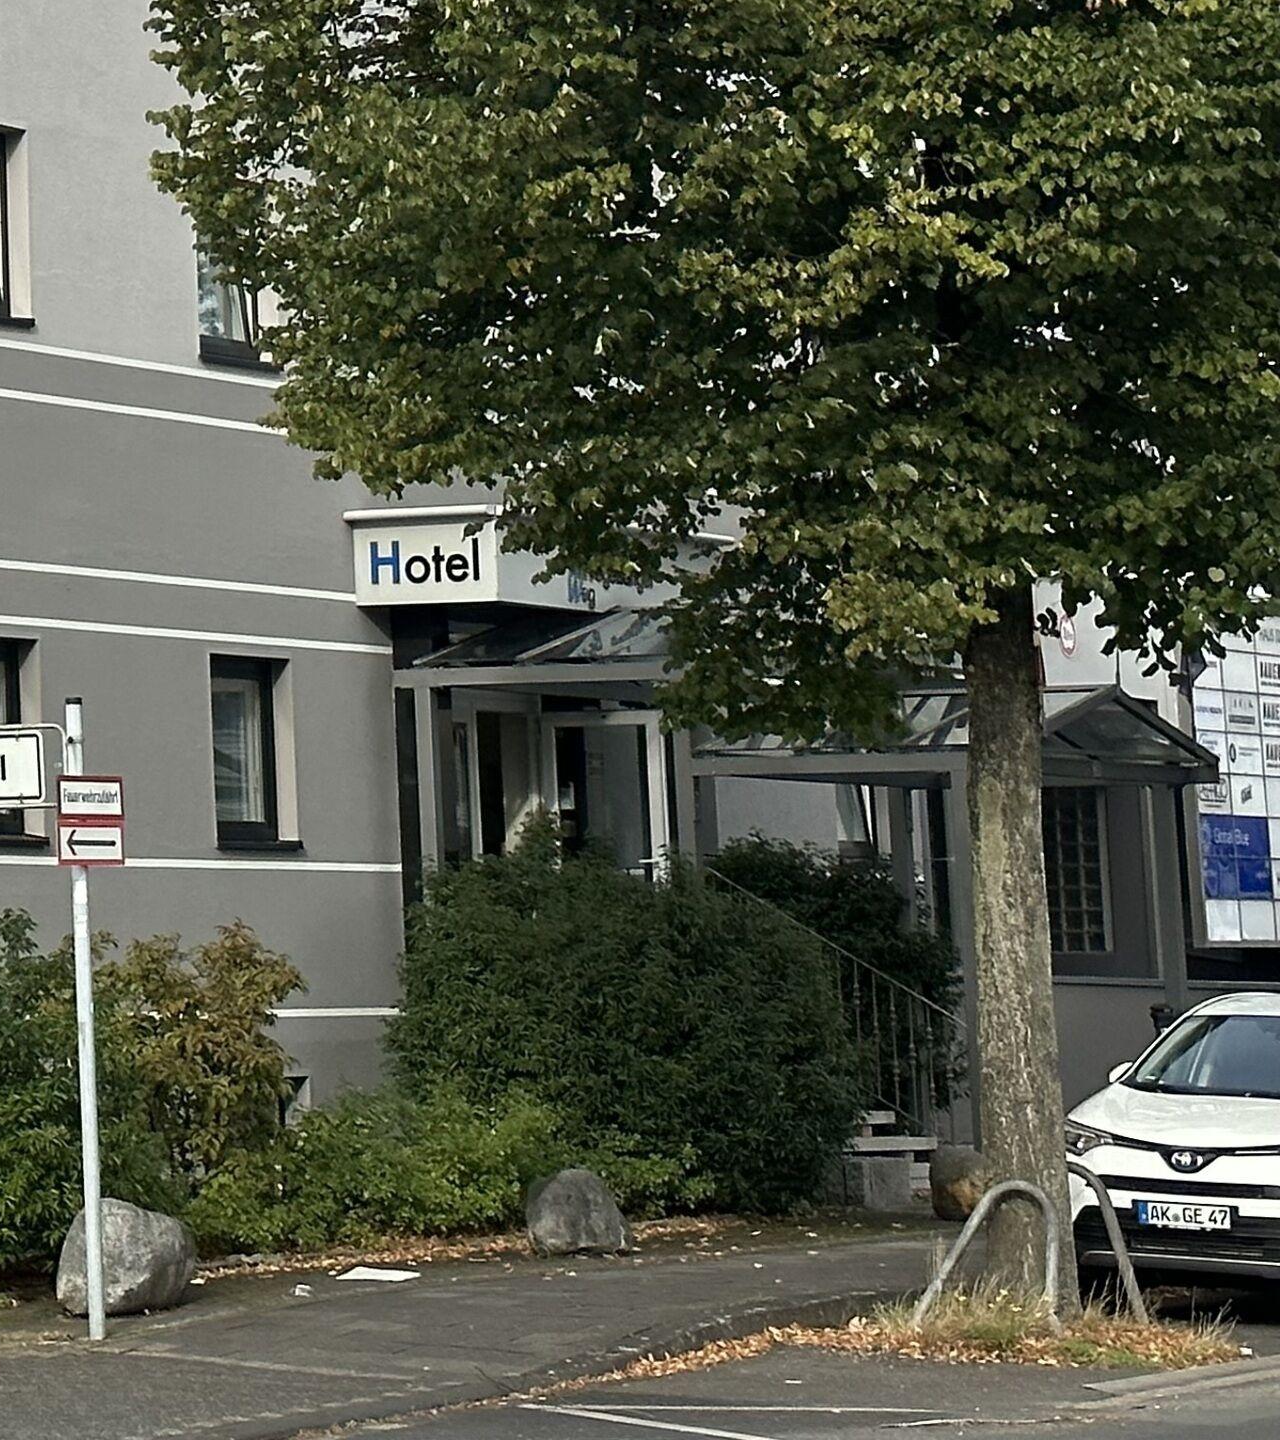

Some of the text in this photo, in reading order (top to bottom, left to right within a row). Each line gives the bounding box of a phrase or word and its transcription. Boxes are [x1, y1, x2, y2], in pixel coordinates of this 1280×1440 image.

[369, 537, 480, 585] Hotel
[1150, 1205, 1228, 1226] AK GE 47
